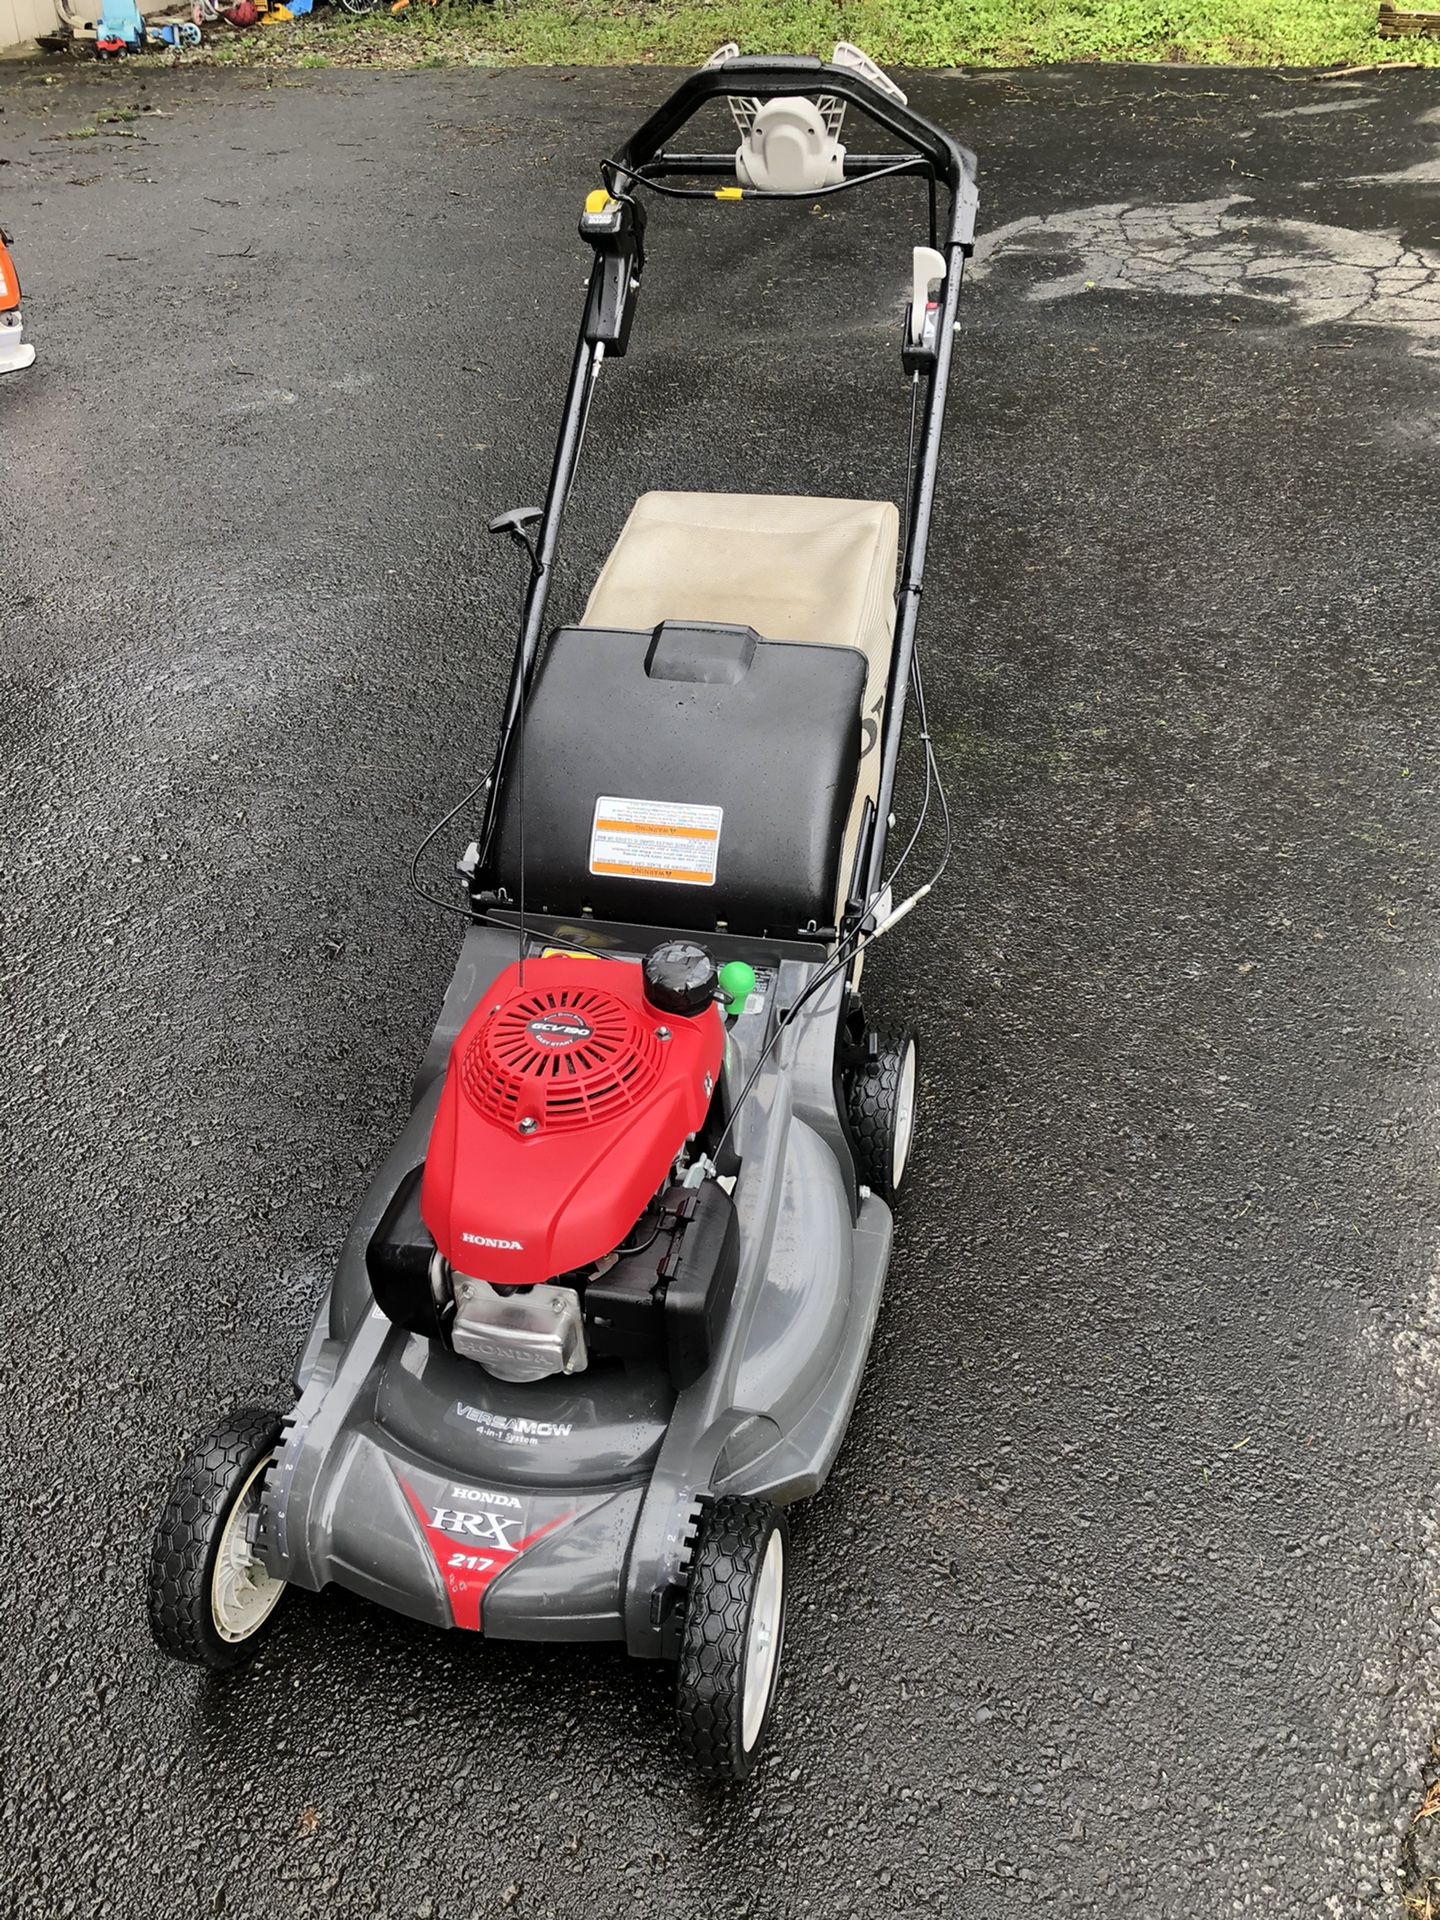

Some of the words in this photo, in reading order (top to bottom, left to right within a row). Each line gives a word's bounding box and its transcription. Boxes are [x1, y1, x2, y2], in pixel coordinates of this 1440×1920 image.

[635, 825, 669, 835] WARNING
[631, 867, 665, 877] WARNING
[531, 1022, 590, 1036] GCV190
[462, 1232, 524, 1250] HONDA
[459, 1340, 555, 1367] HONDA
[456, 1401, 573, 1436] VERSAMOW
[475, 1425, 503, 1439] 4-in-1
[505, 1432, 539, 1446] System
[451, 1487, 522, 1509] HONDA
[426, 1506, 523, 1553] HRX
[447, 1552, 494, 1572] 217
